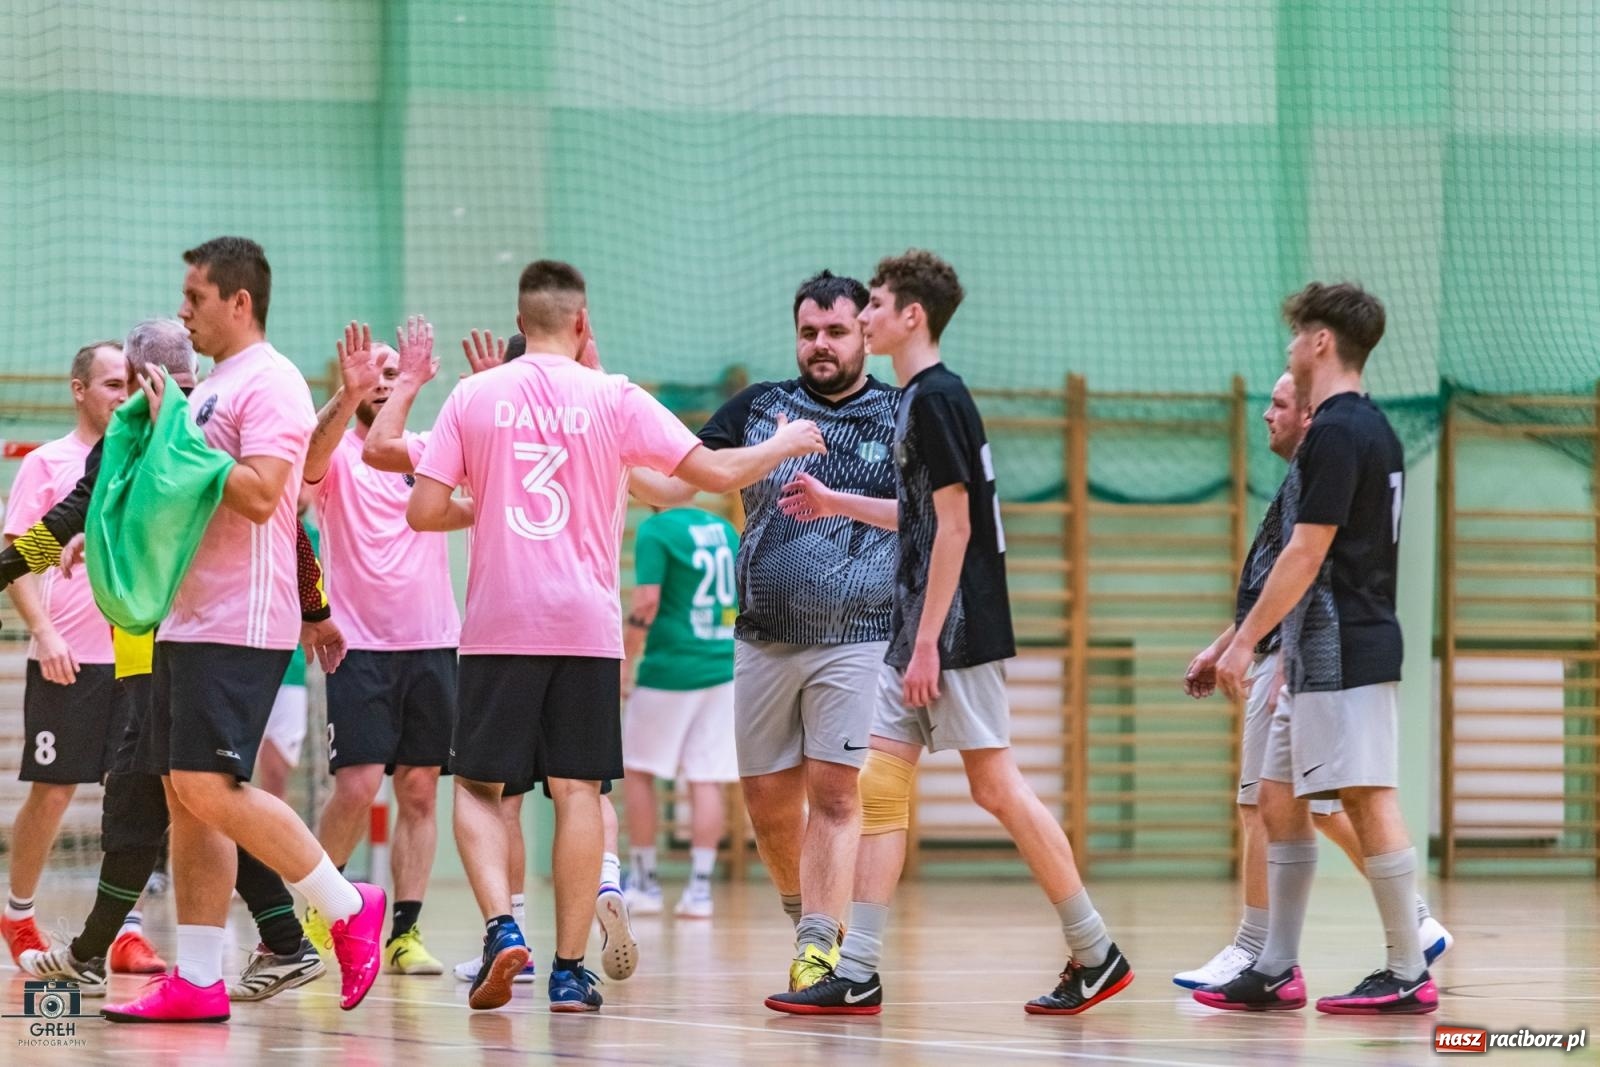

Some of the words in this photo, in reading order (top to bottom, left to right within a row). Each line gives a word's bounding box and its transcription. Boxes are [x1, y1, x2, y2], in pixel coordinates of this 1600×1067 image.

[495, 400, 591, 434] DAWID
[505, 441, 571, 541] 3
[691, 546, 736, 607] 20
[34, 730, 57, 765] 8
